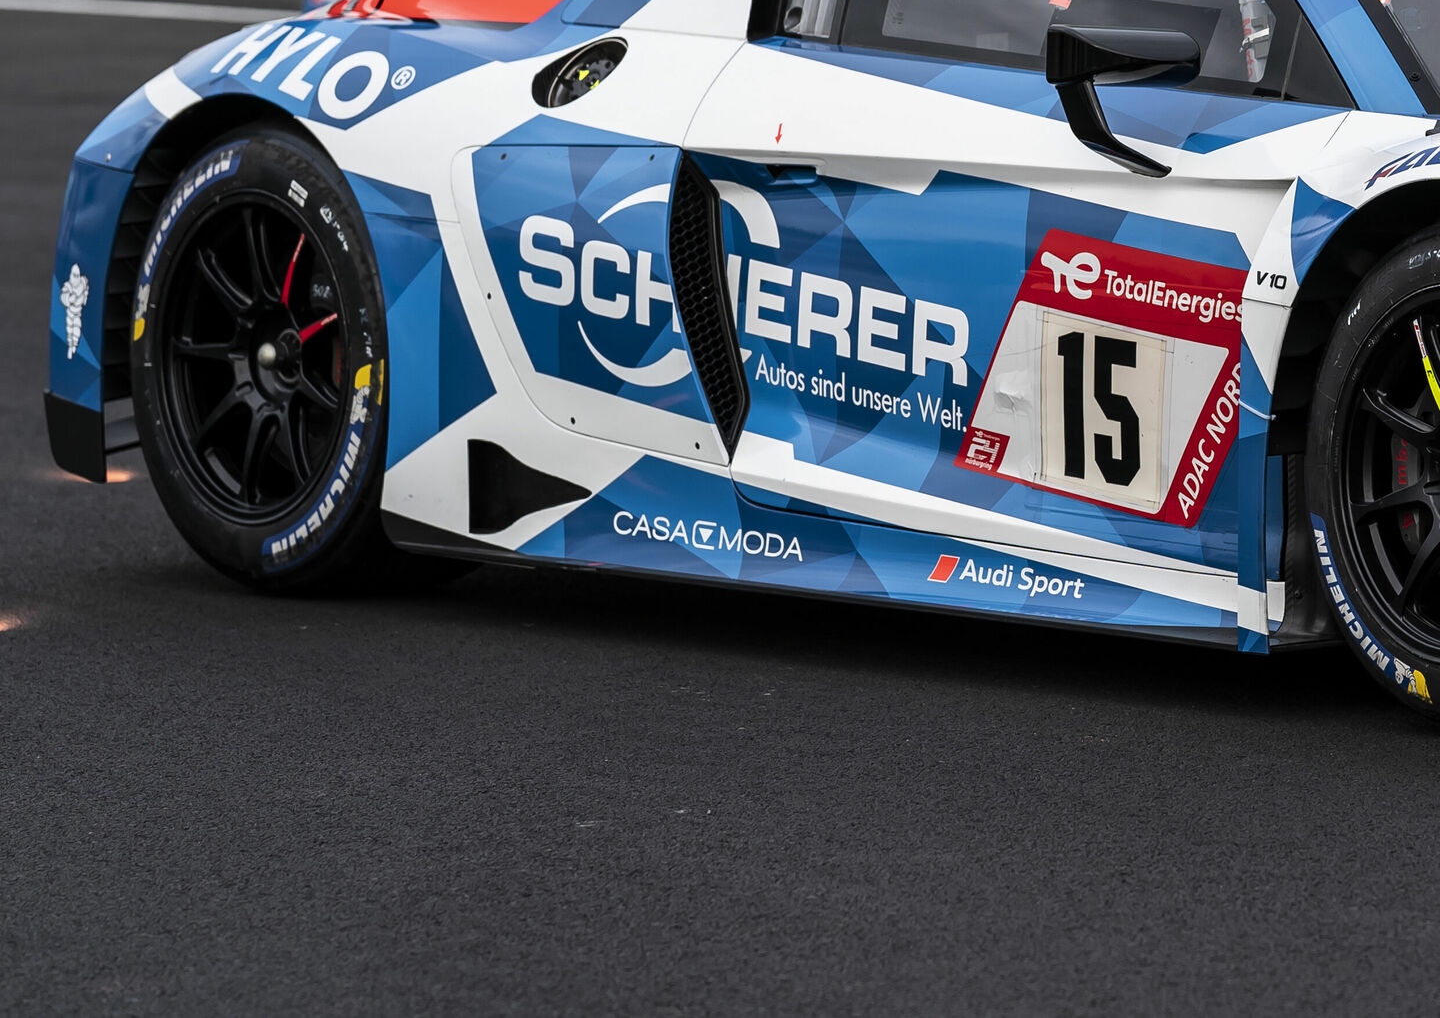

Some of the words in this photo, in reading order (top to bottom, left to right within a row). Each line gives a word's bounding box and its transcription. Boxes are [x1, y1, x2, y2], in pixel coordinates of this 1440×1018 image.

[144, 148, 234, 277] MICHELIN
[1103, 268, 1242, 323] TotalEnergies
[1255, 270, 1287, 290] V10
[755, 352, 806, 393] Autos
[811, 368, 846, 403] sind
[851, 385, 912, 419] unsere
[916, 391, 968, 433] Welt.
[1057, 330, 1141, 487] 15
[270, 430, 362, 565] MICHELIN
[1177, 437, 1216, 520] ADAC
[959, 557, 1014, 588] Audi
[1018, 567, 1085, 600] Sport
[1312, 528, 1390, 674] MICHELIN
